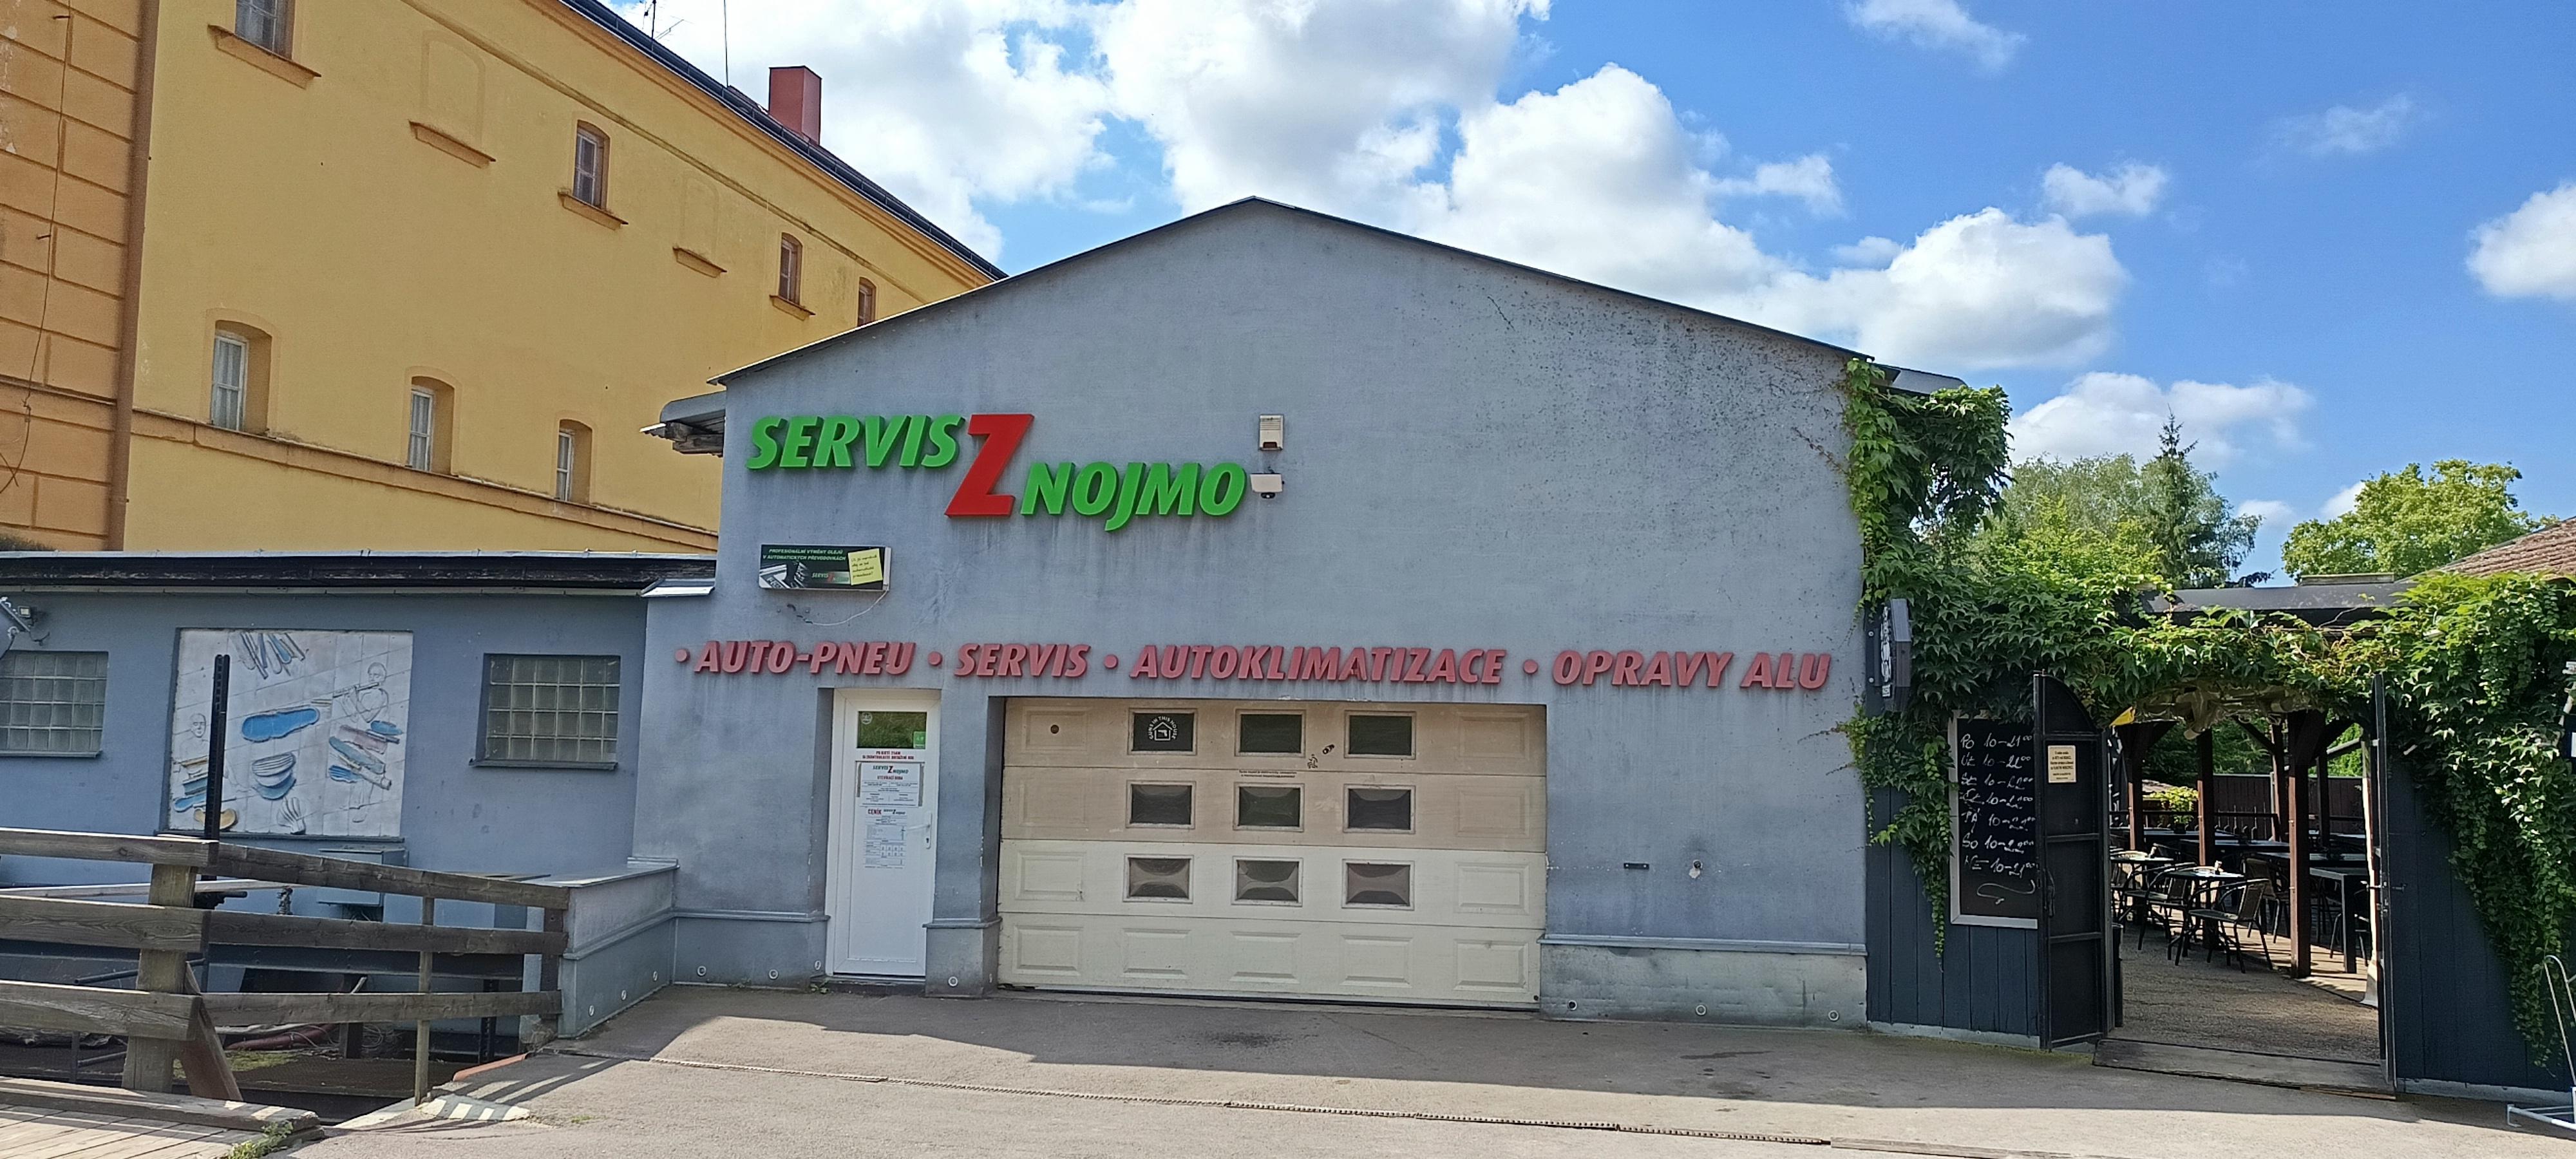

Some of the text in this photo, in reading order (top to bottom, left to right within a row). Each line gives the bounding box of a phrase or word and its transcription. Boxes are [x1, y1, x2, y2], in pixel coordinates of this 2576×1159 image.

[746, 414, 965, 472] SERVIS
[695, 641, 1832, 691] AUTO-PNEU SERVIS AUTOKLIMATIZACE OPRAVY ALU
